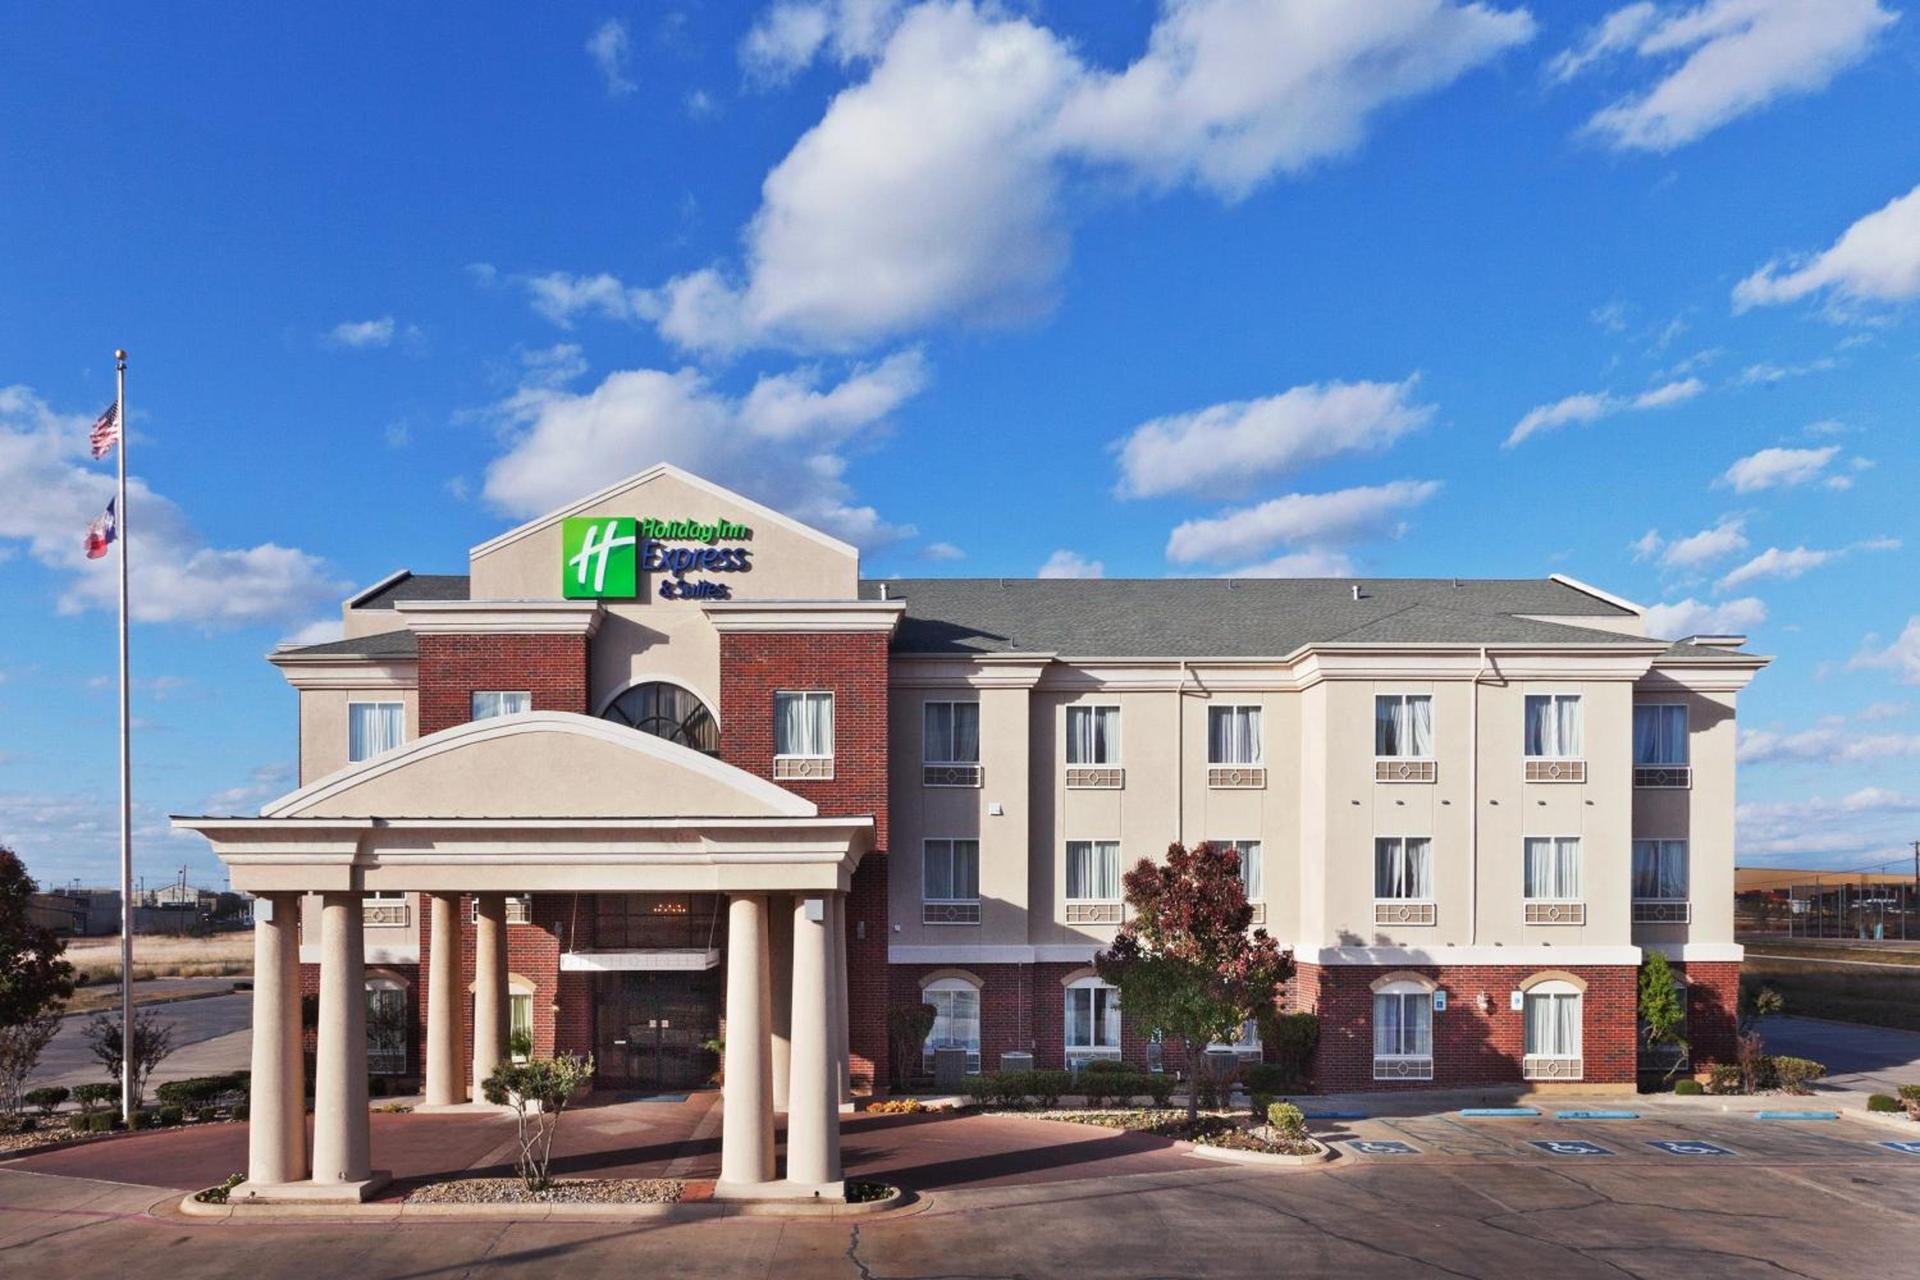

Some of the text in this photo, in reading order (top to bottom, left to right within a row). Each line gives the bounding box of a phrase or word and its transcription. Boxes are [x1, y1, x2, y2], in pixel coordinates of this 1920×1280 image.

[642, 517, 746, 542] Holiday Inn
[641, 540, 749, 578] Express
[659, 579, 728, 600] & Suites
